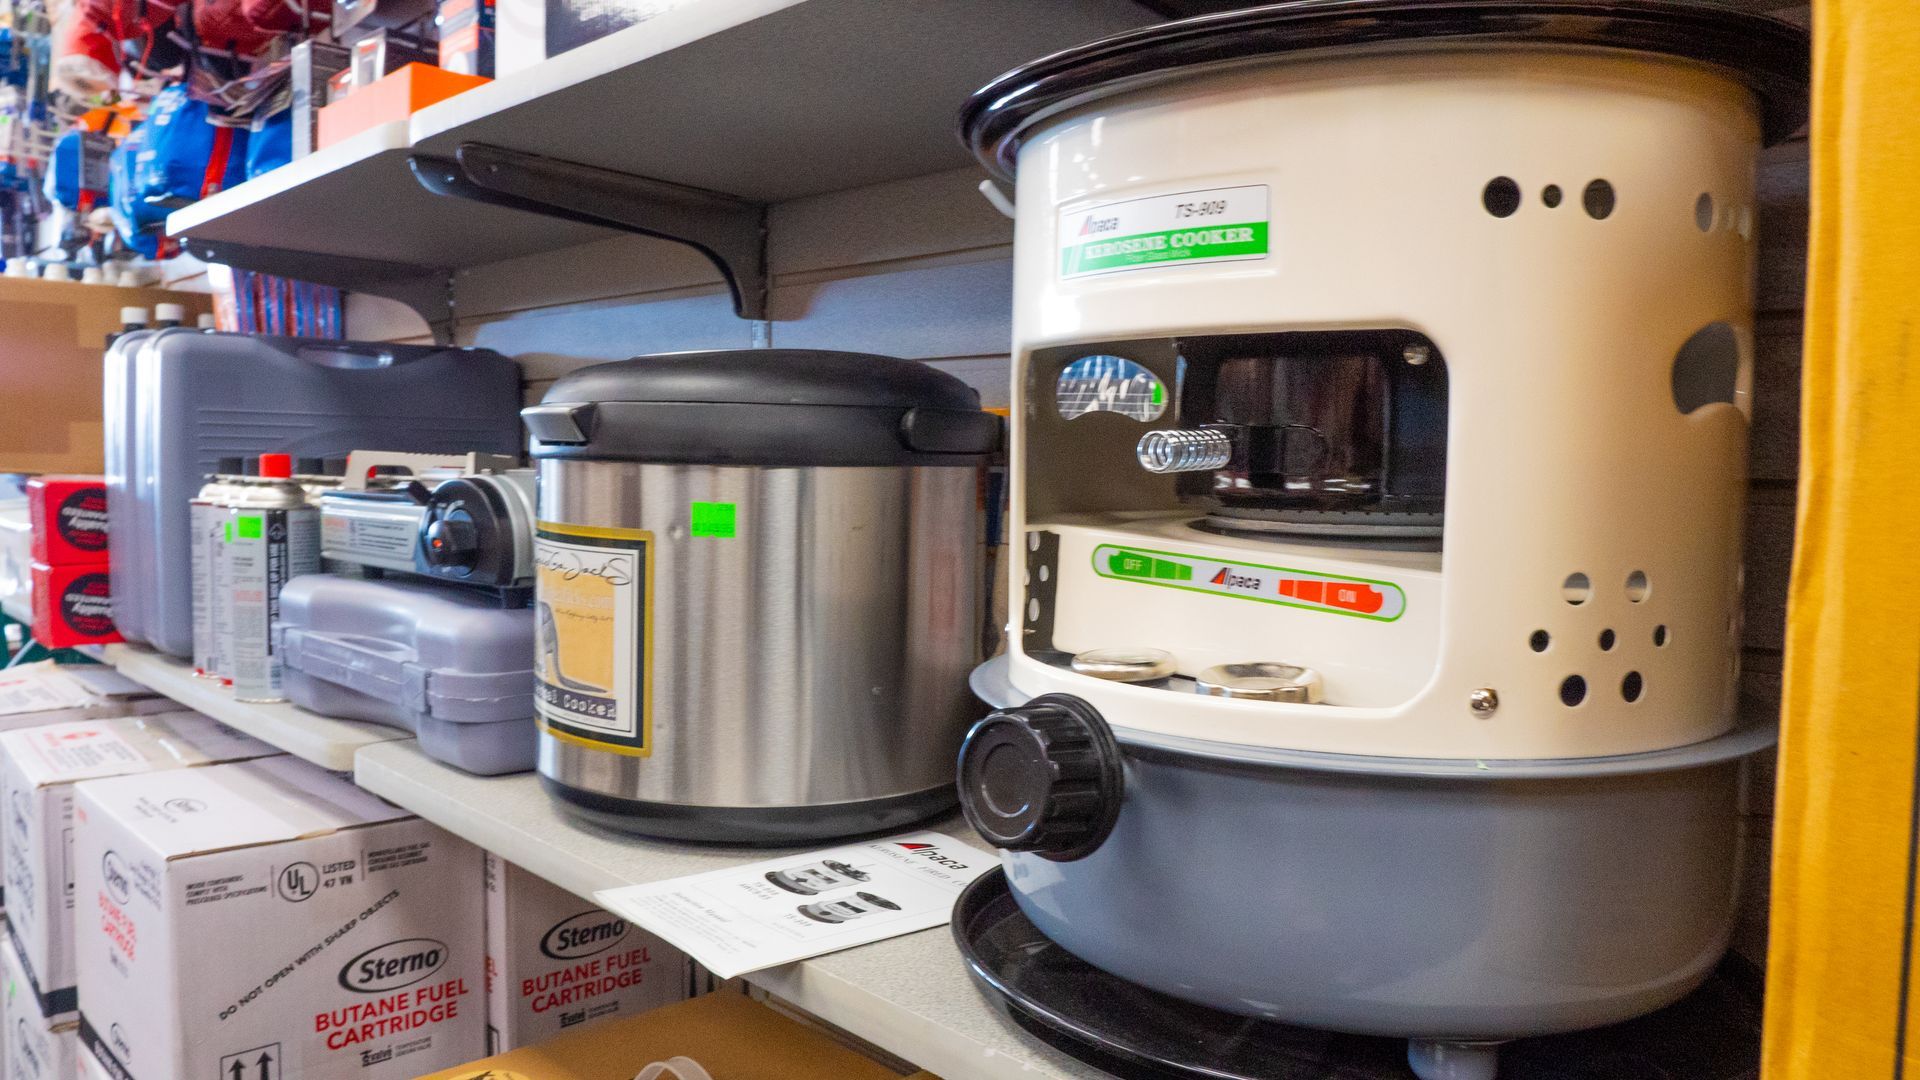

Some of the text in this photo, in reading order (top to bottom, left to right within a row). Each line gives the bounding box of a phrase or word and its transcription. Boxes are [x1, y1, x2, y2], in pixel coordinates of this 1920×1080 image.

[1174, 200, 1228, 219] TS-909
[1085, 227, 1255, 260] KEROSENE COOKER
[1122, 558, 1143, 571] OFF
[1210, 566, 1262, 590] Alpaca
[1338, 590, 1358, 603] ON
[322, 860, 356, 874] LISTED
[894, 842, 970, 870] Alpaca
[287, 868, 311, 896] UL
[323, 877, 336, 889] 47
[556, 919, 625, 951] Sterno
[218, 888, 401, 1021] DO NOT OPEN WITH SHARP OBJECTS
[358, 948, 441, 984] Sterno
[522, 959, 601, 997] BUTANE
[606, 946, 652, 972] FUEL
[315, 977, 469, 1033] BUTANE FUEL
[531, 968, 643, 1014] CARTRIDGE
[326, 1000, 458, 1050] CARTRIDGE
